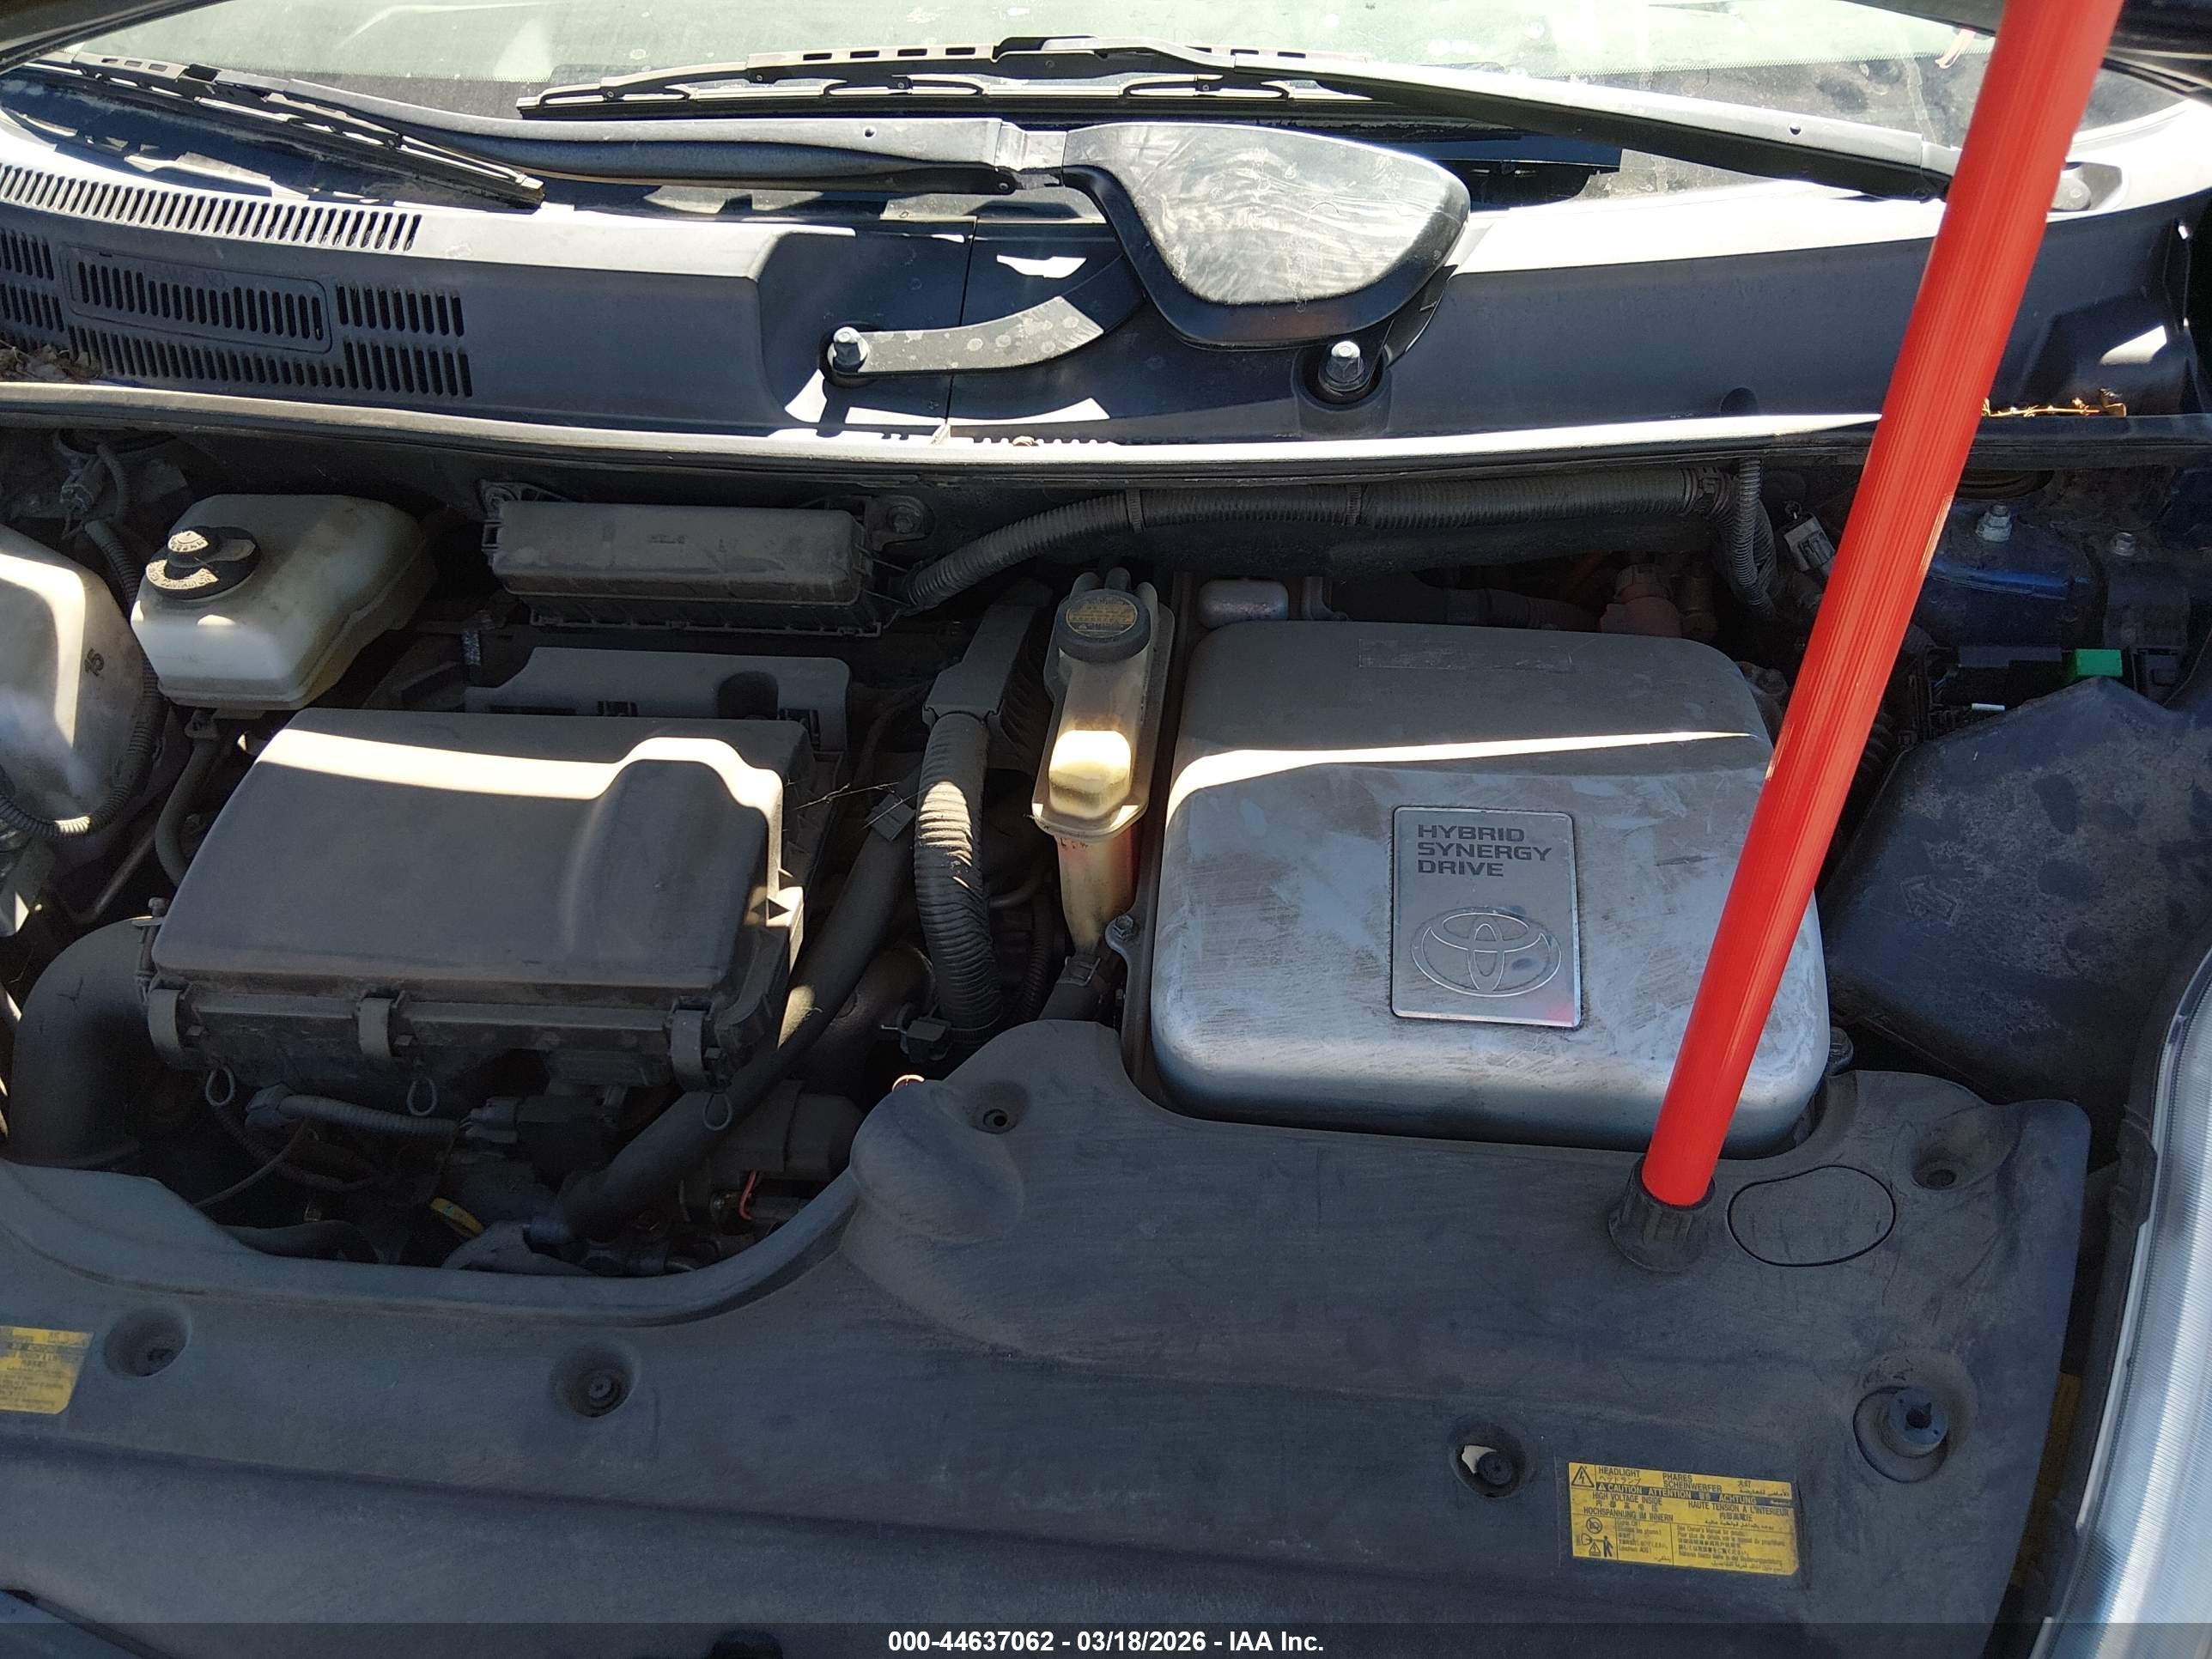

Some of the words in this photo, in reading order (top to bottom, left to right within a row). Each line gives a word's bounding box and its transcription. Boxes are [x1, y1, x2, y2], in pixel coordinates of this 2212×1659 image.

[1418, 823, 1525, 842] HYBRID
[1418, 842, 1553, 861] SYNERGY
[1418, 860, 1504, 878] DRIVE
[1598, 1466, 1640, 1478] HEADLIGHT
[1662, 1472, 1692, 1483] PHARES
[1607, 1484, 1643, 1494] CAUTION
[1663, 1480, 1722, 1492] SCHEINWERFER
[1592, 1491, 1608, 1500] HIGH
[1611, 1492, 1638, 1503] VOLTAGE
[1642, 1496, 1662, 1506] INSIDE
[1648, 1488, 1691, 1499] ATTENTION
[1718, 1493, 1757, 1505] ACHTUNG
[1688, 1501, 1710, 1510] HAUTE
[1712, 1503, 1740, 1513] TENSION
[1583, 1506, 1637, 1519] HOCHSPANNUNG
[1650, 1512, 1674, 1522] INNERN
